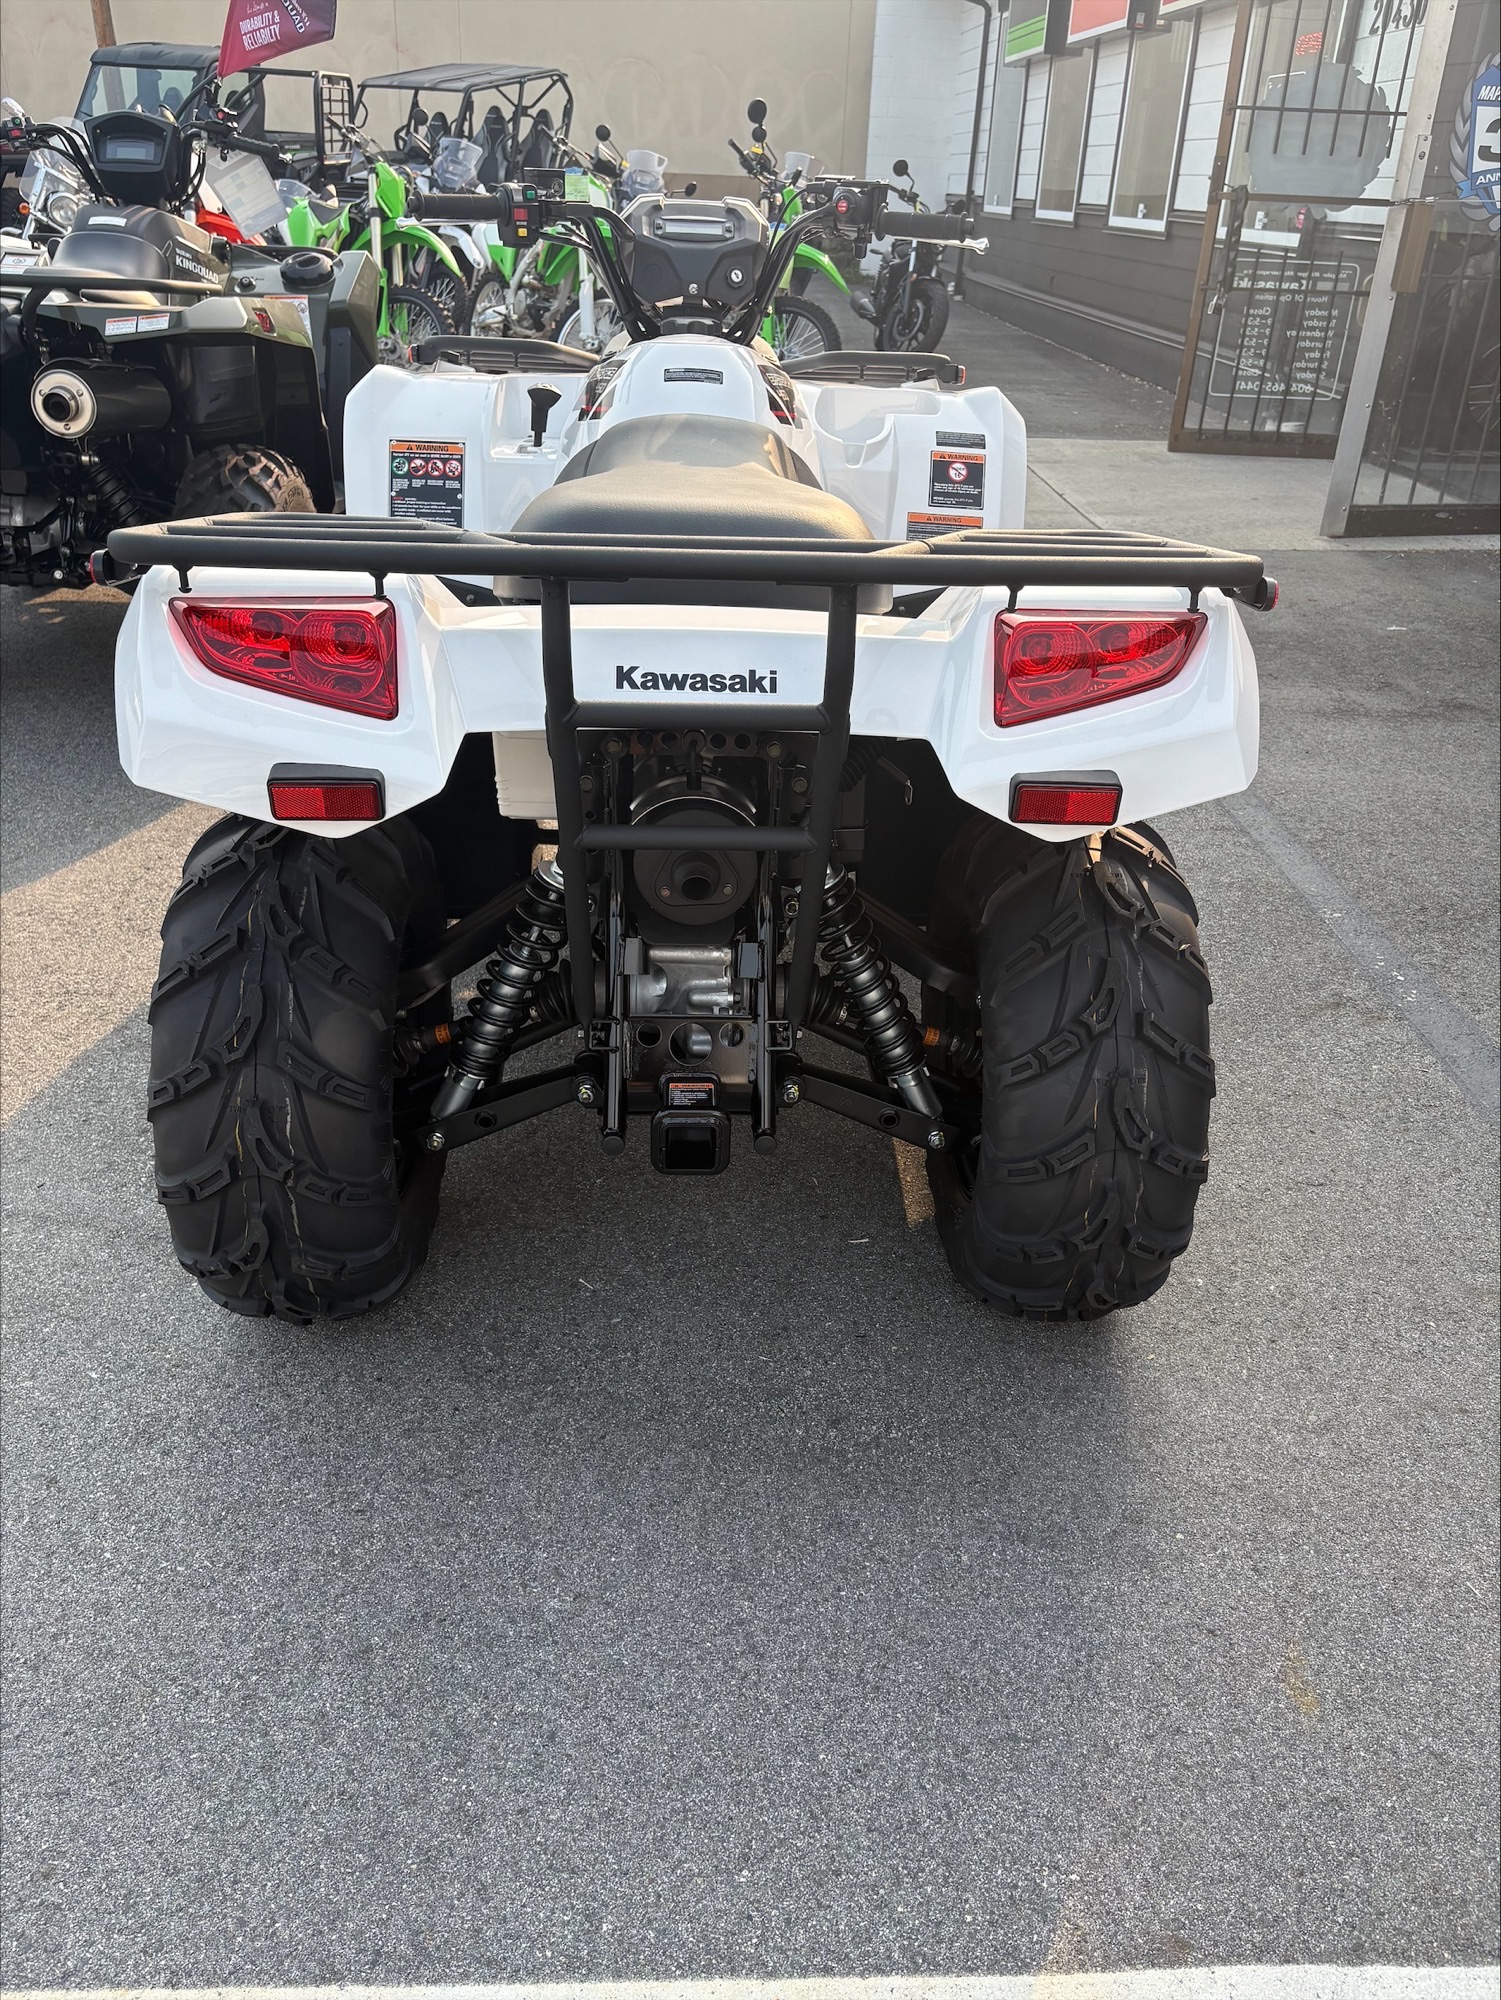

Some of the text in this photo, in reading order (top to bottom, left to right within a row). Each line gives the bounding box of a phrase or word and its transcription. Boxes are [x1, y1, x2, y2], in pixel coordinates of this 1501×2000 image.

[240, 12, 273, 34] DURABILITY
[274, 10, 280, 23] &
[415, 444, 449, 452] WARNING
[947, 453, 979, 461] WARNING
[616, 665, 777, 693] Kawasaki
